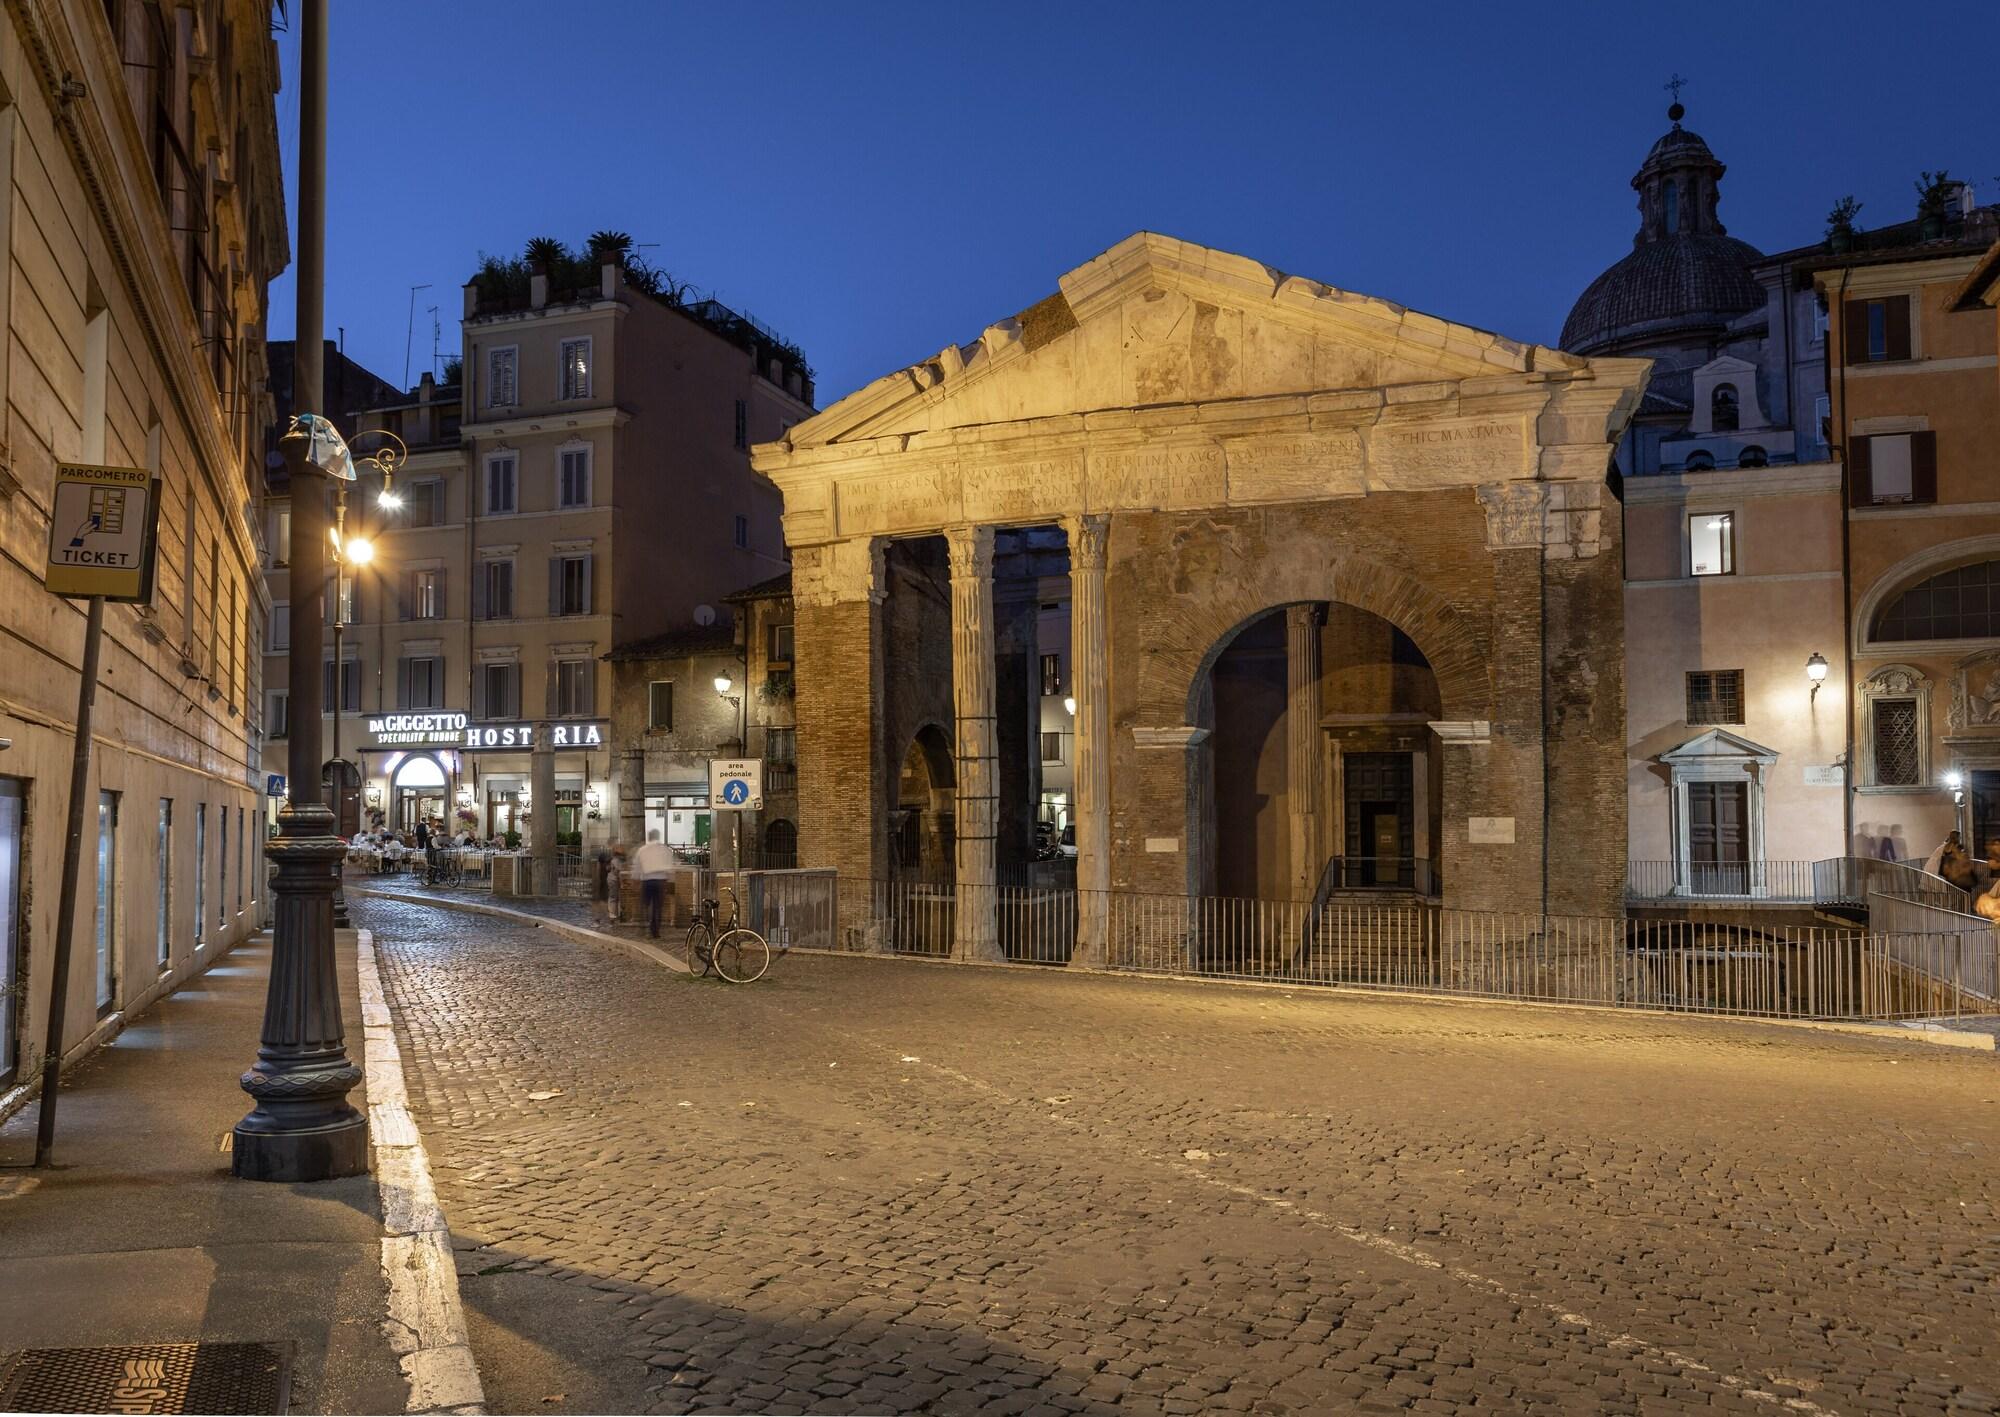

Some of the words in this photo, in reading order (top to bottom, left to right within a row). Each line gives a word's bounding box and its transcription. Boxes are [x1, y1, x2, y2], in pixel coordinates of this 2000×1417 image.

[60, 467, 146, 482] PARCOMETRO
[62, 549, 129, 566] TICKET
[369, 720, 385, 732] DA
[385, 713, 467, 732] GIGGETTO
[466, 725, 601, 746] HOSTRIA
[109, 1388, 168, 1414] SIP
